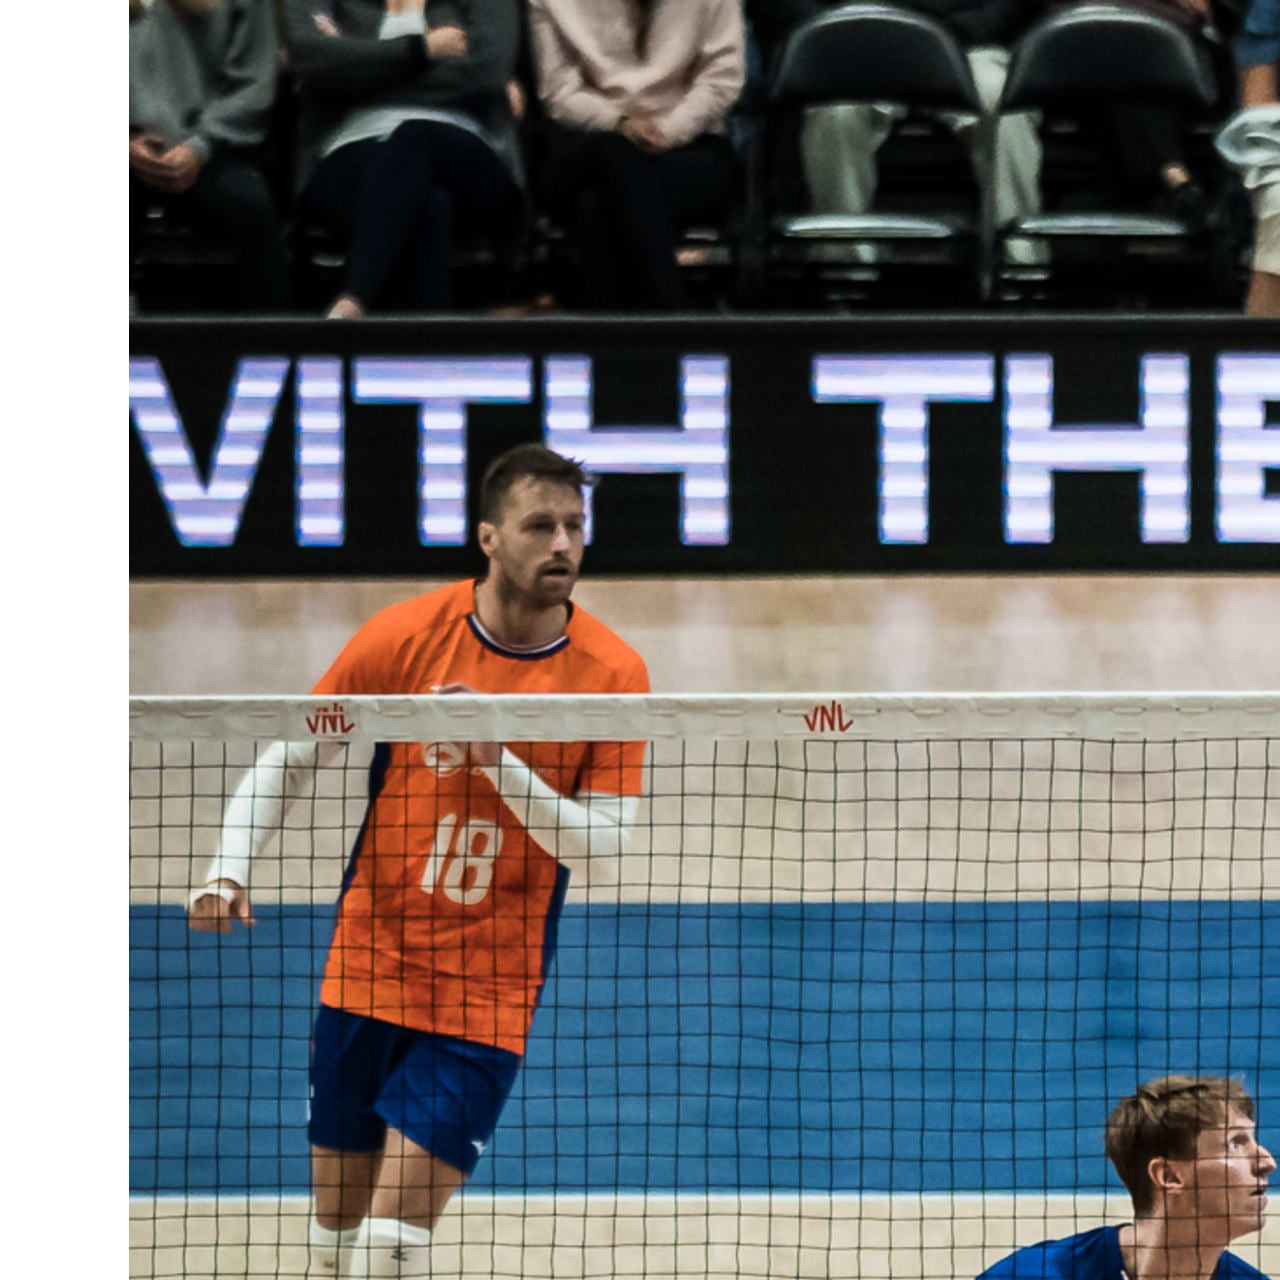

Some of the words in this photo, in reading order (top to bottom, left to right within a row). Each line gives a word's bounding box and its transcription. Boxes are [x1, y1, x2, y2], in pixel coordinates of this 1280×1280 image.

[305, 702, 356, 734] VNL
[803, 699, 854, 732] VNL
[420, 812, 504, 906] 18
